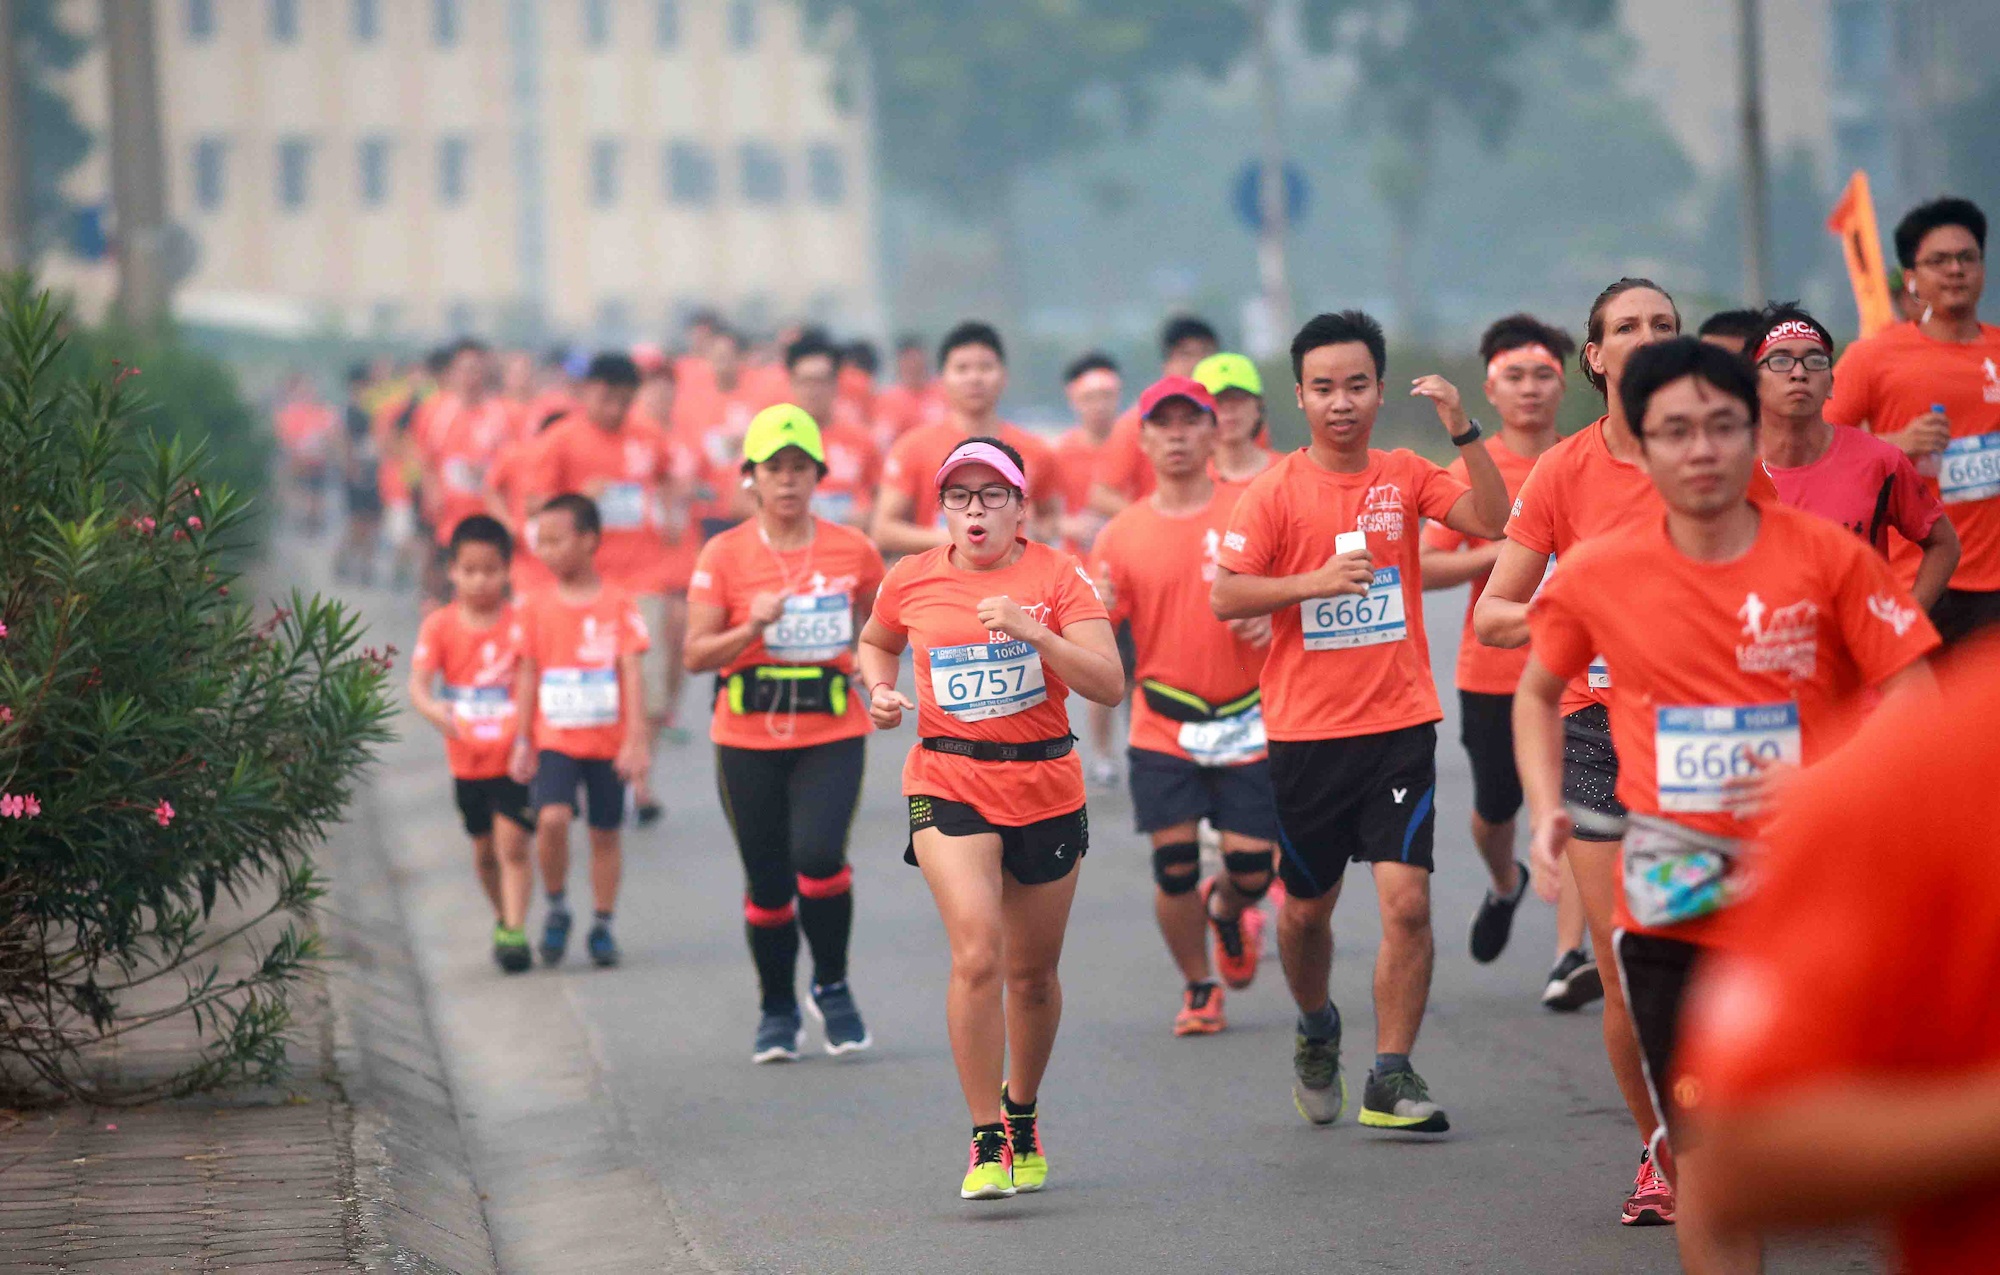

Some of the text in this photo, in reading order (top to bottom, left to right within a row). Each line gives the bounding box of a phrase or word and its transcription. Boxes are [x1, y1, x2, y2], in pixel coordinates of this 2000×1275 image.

[1315, 594, 1389, 629] 6667
[777, 616, 841, 643] 6665
[994, 642, 1028, 660] 10KM
[947, 664, 1026, 701] 6757
